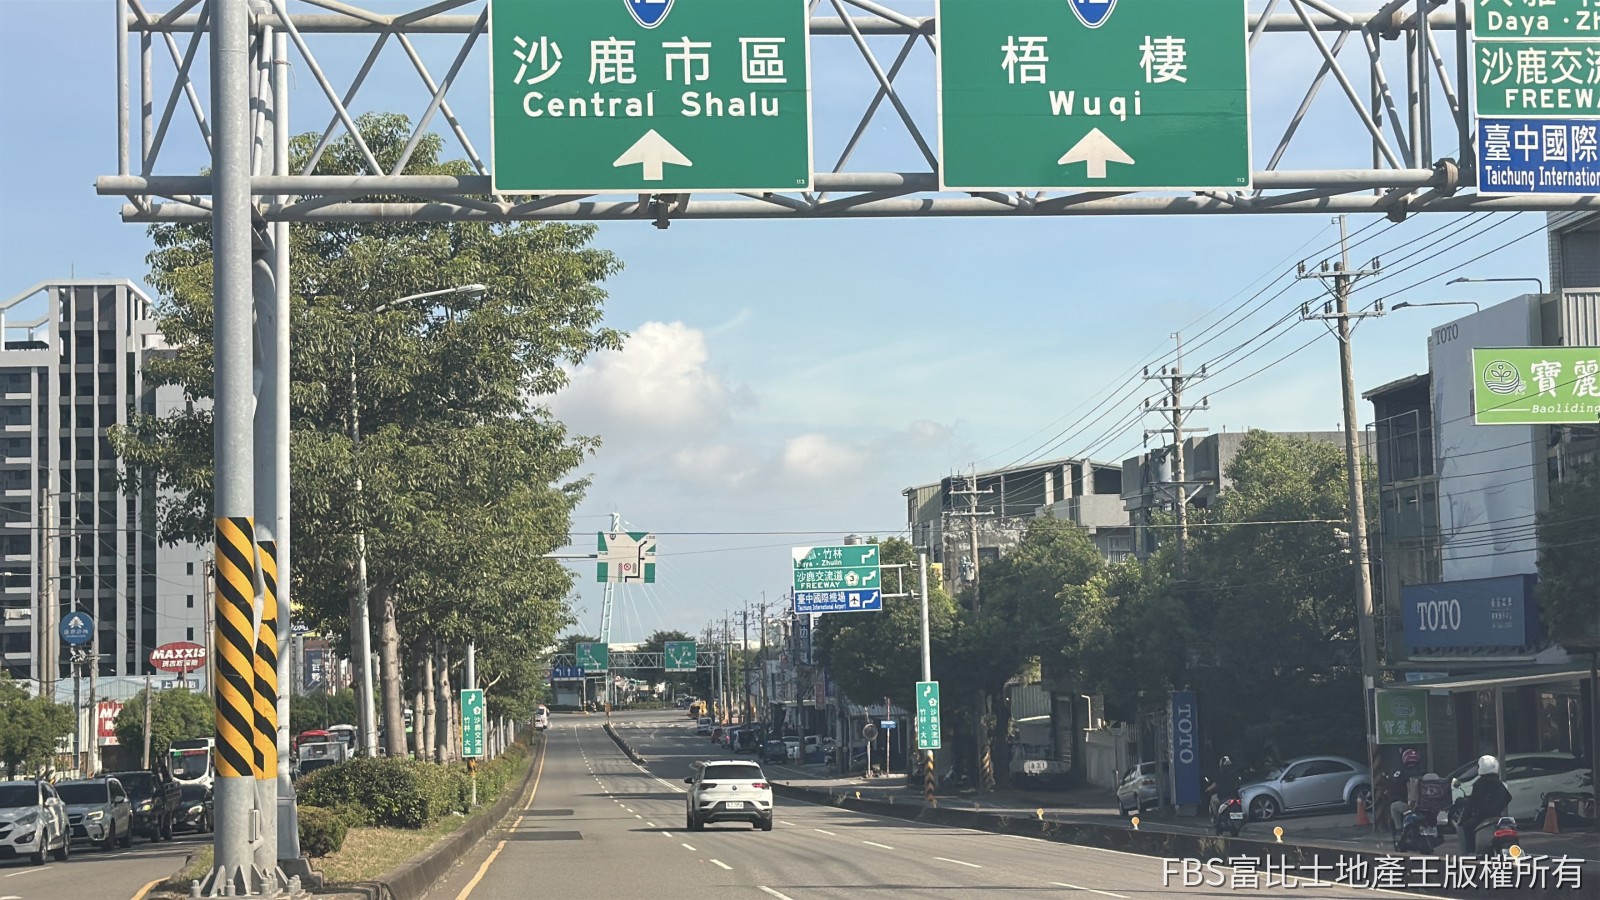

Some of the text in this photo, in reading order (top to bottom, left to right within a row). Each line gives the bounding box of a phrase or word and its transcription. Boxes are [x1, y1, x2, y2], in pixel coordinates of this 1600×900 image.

[1488, 11, 1549, 35] Daya
[512, 35, 787, 85] 沙鹿市區
[1001, 35, 1188, 84] 梧棲
[522, 91, 779, 117] Central Shalu
[1048, 90, 1142, 122] Wuqi
[1484, 124, 1598, 162] 臺中國際
[1485, 165, 1535, 191] Taichung
[1435, 323, 1459, 346] TOTO
[1530, 359, 1600, 398] 寶麗
[796, 570, 843, 582] 沙鹿交流道
[797, 592, 846, 604] 臺中國際機場
[1417, 599, 1461, 631] TOTO
[152, 648, 206, 660] MAXXIS
[1178, 704, 1194, 764] TOTO
